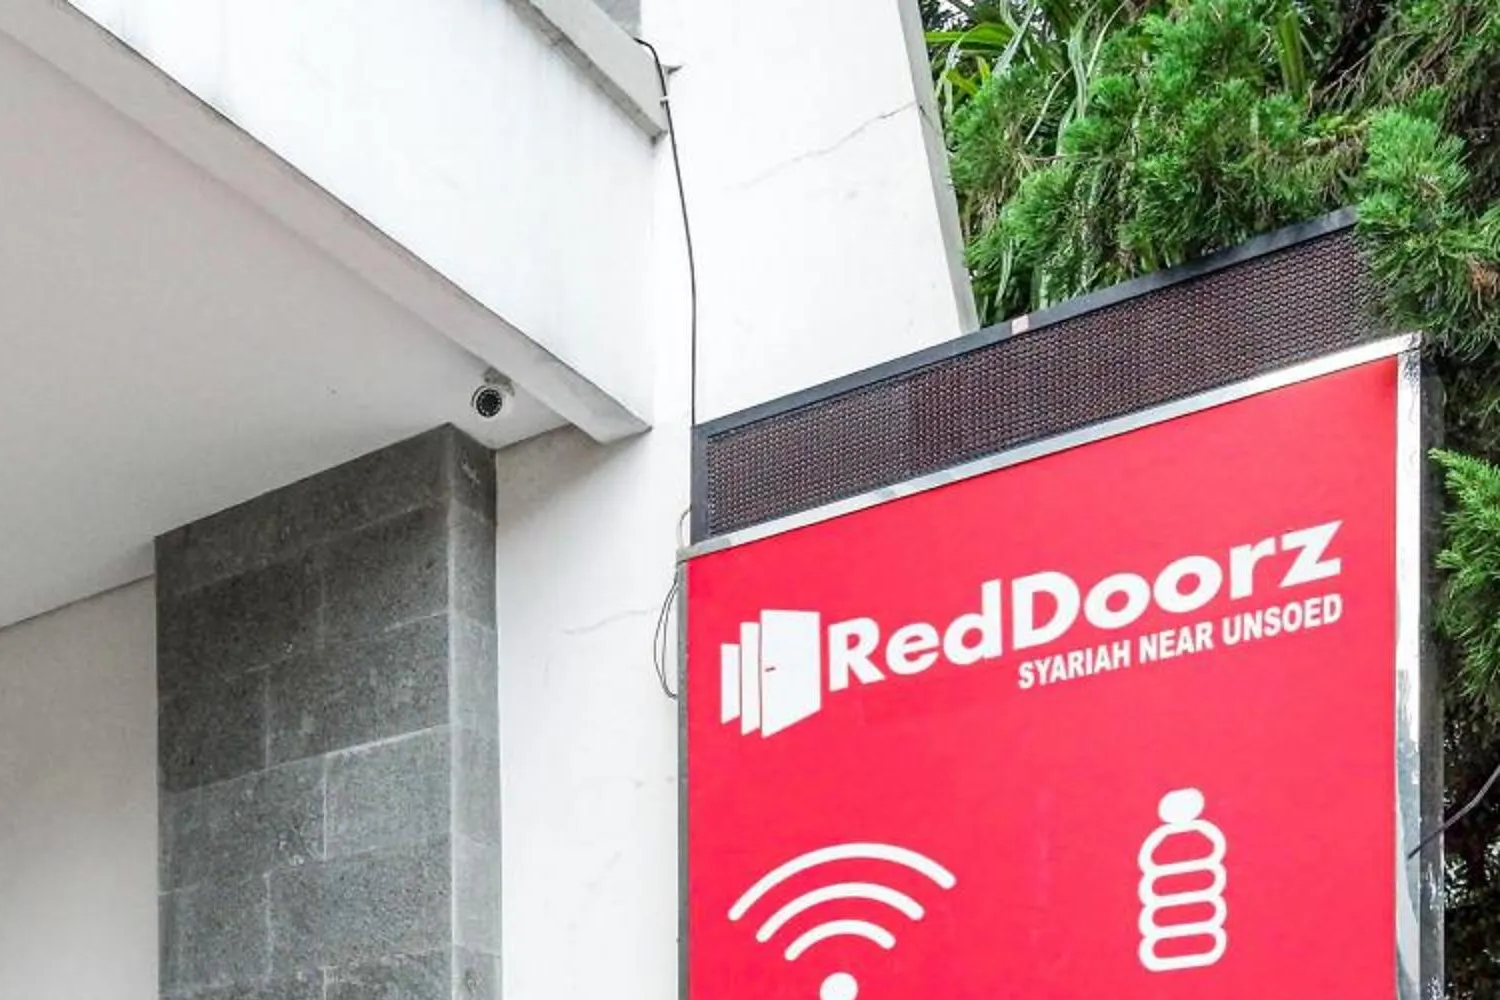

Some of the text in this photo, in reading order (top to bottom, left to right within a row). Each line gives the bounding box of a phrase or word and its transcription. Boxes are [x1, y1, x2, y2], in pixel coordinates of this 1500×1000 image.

[827, 519, 1343, 692] RedDoorz
[1018, 593, 1343, 689] SYARIAH NEAR UNSOED
